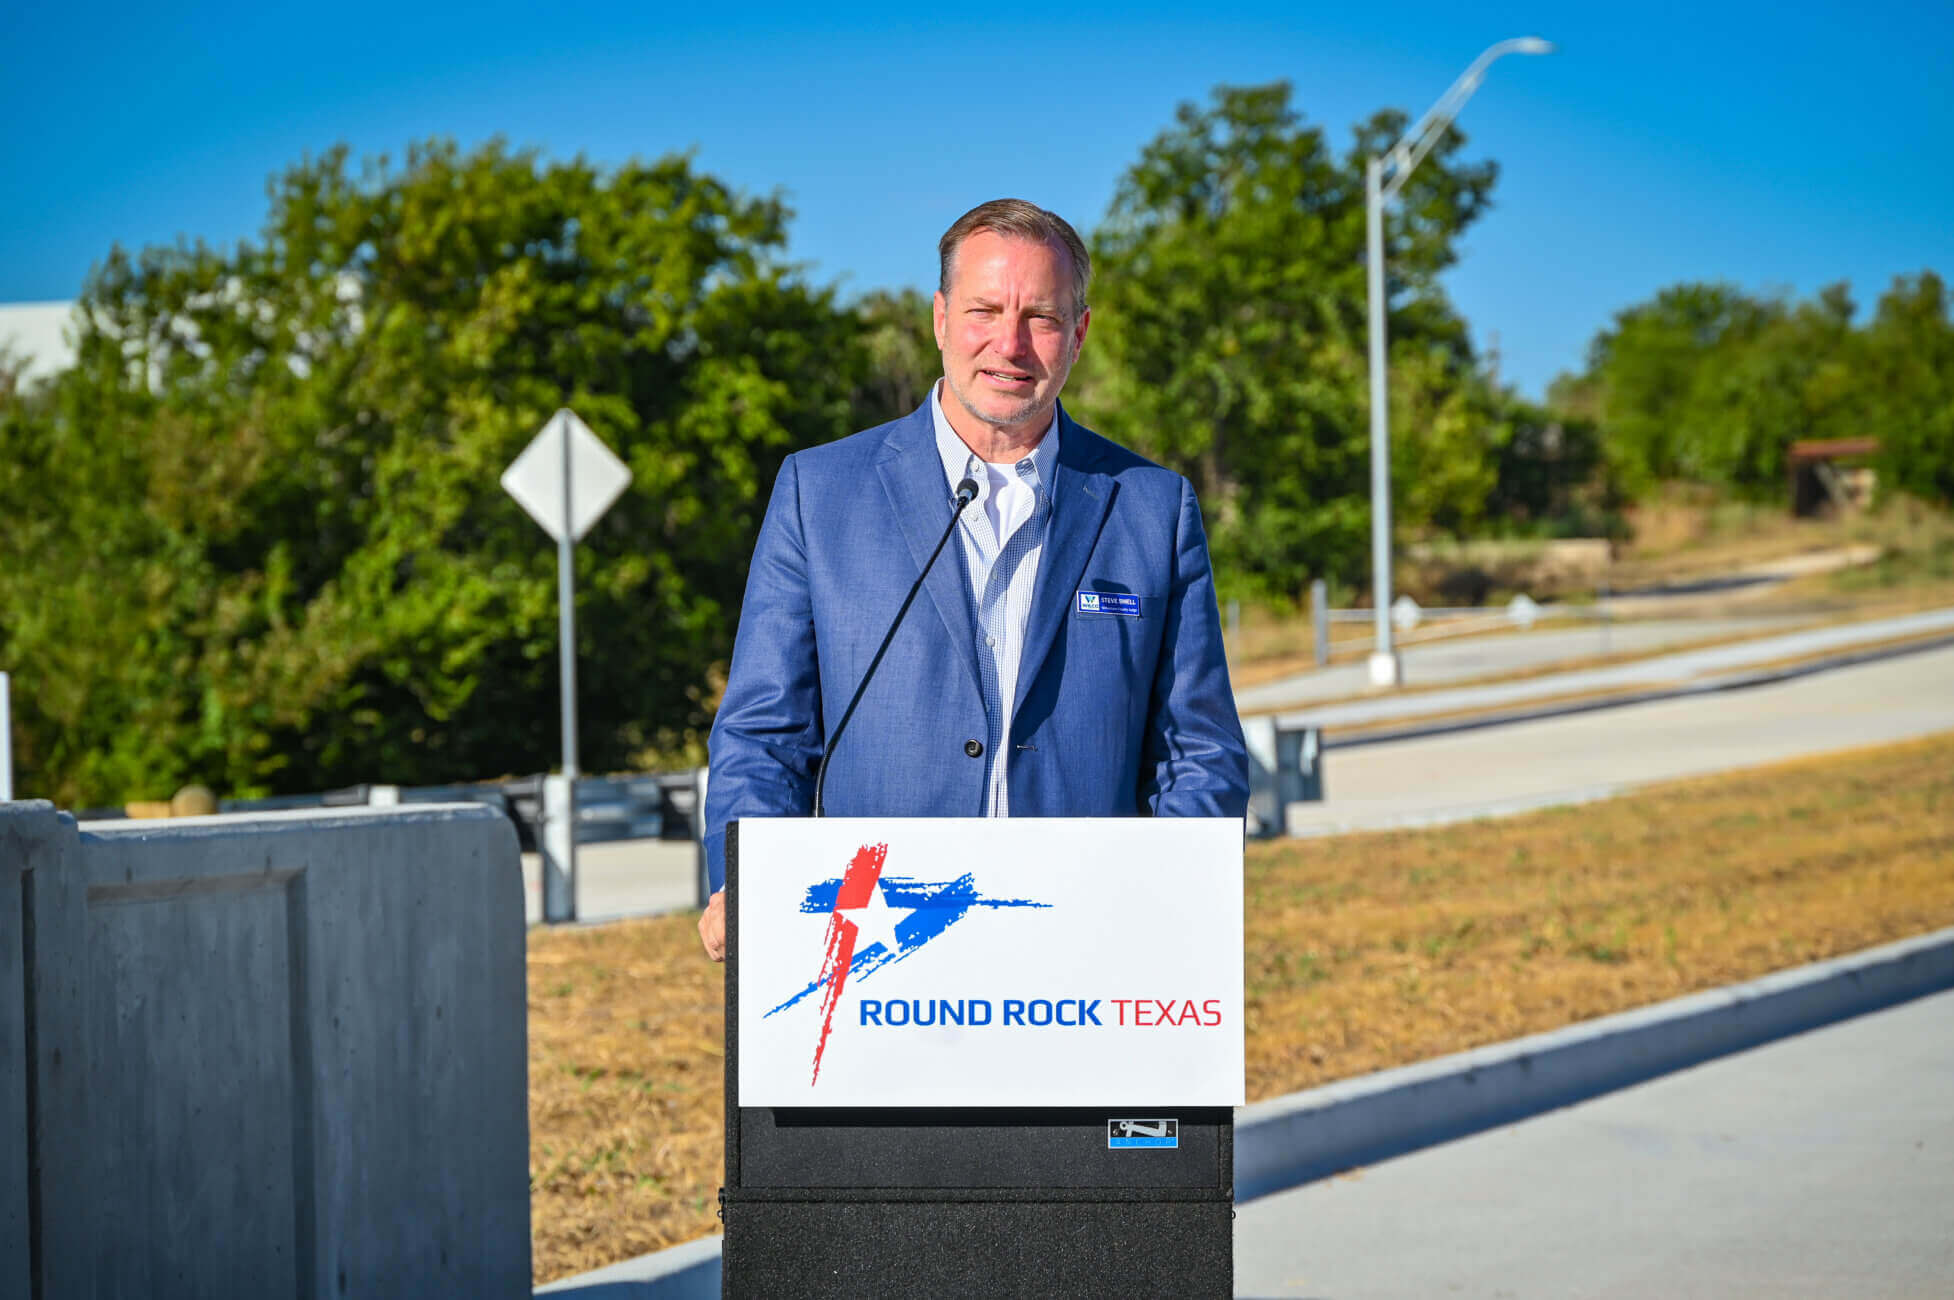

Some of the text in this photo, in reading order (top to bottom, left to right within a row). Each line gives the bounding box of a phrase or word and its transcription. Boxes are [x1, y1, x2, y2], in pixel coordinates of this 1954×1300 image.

[860, 999, 1222, 1026] ROUND ROCK TEXAS
